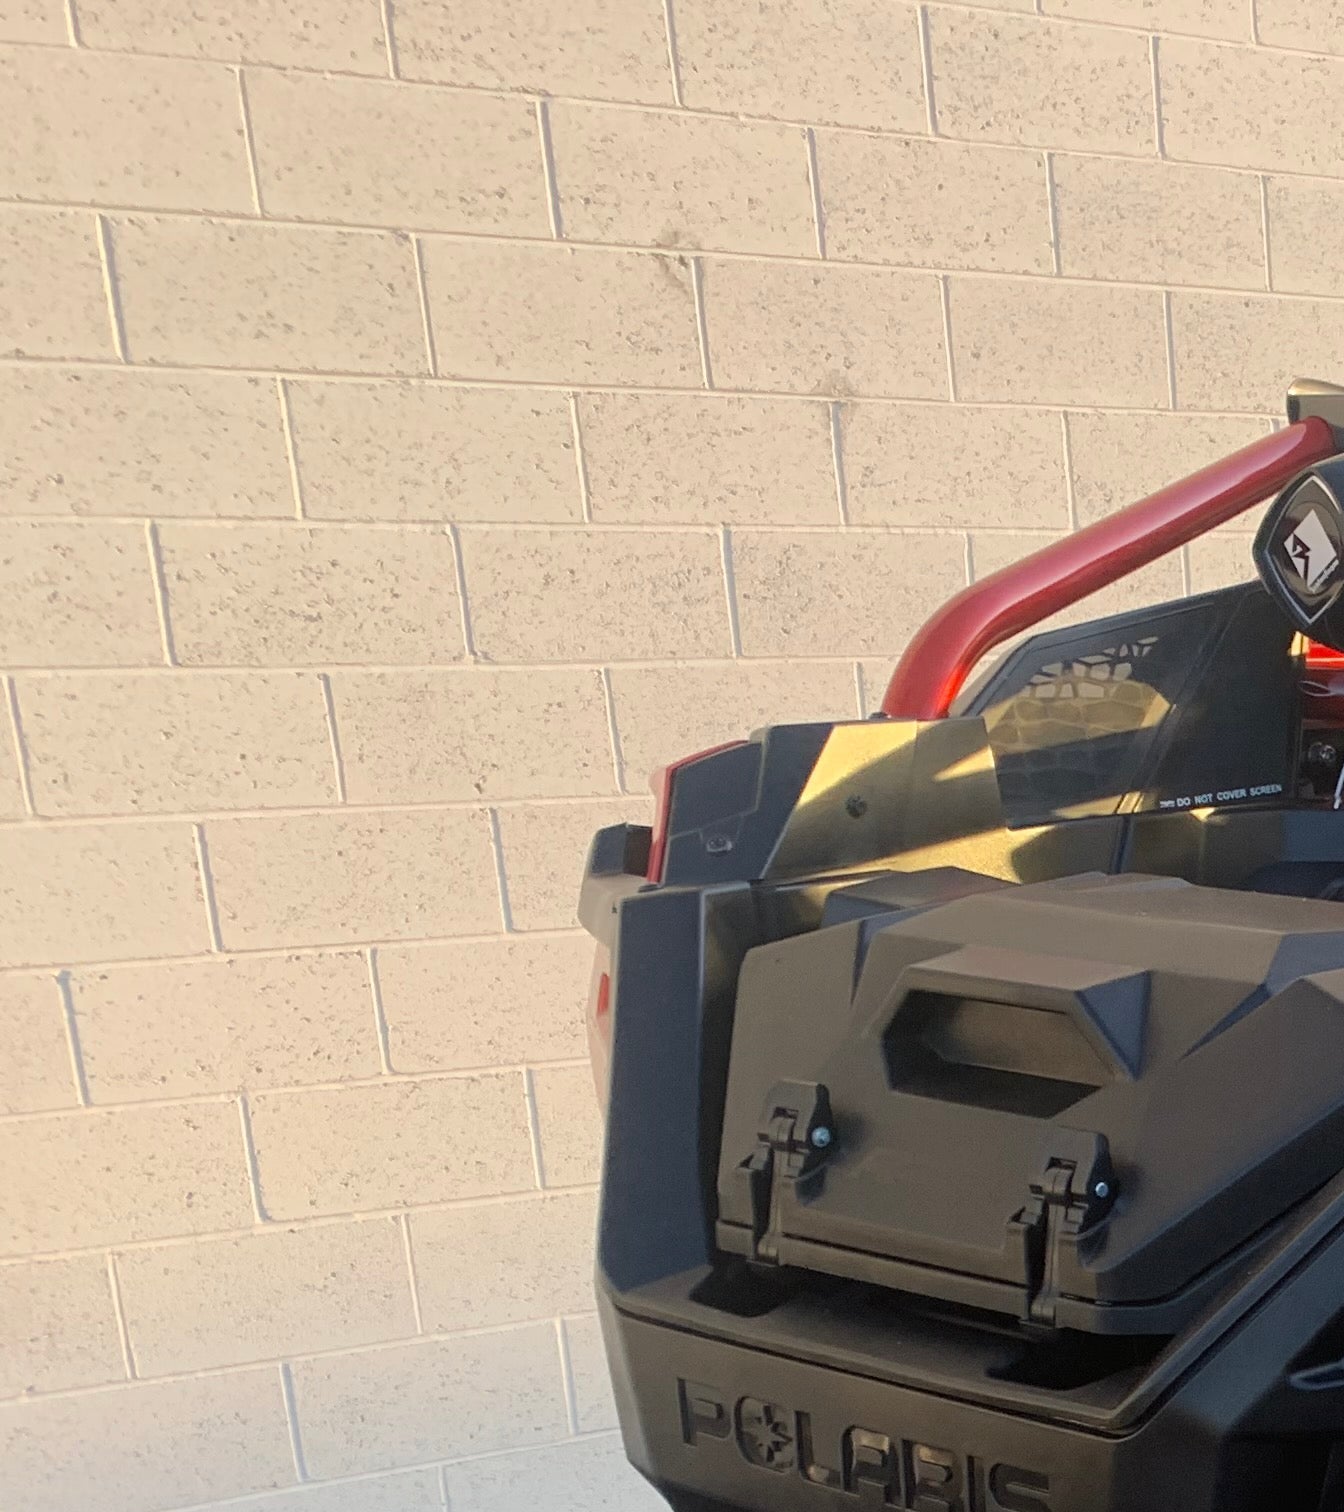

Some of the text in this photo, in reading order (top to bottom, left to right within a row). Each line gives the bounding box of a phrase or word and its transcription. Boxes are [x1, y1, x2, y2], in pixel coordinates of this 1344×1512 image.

[1176, 797, 1191, 807] DO
[1194, 793, 1213, 804] NOT
[1216, 788, 1247, 801] COVER
[1249, 784, 1282, 796] SCREEN
